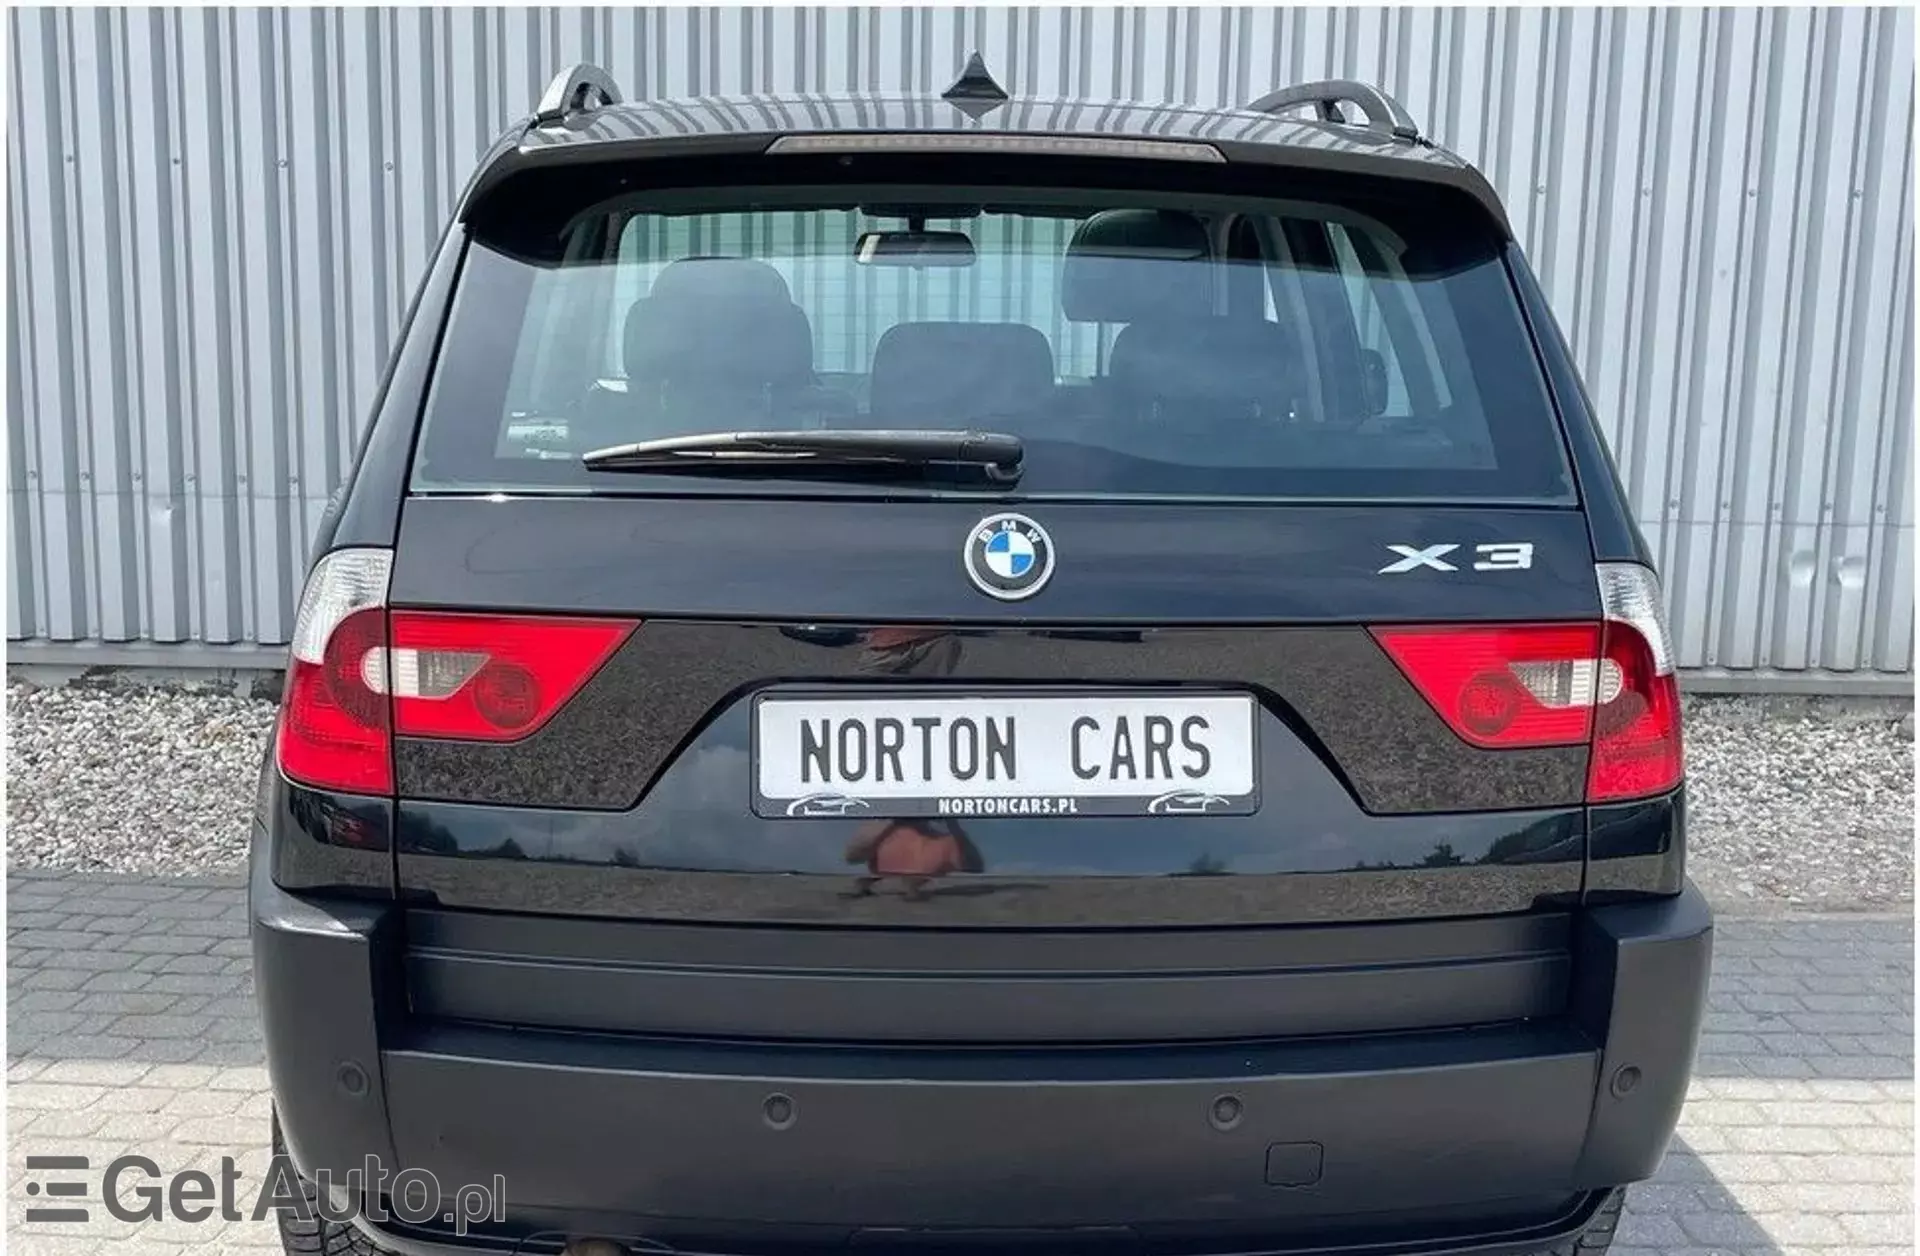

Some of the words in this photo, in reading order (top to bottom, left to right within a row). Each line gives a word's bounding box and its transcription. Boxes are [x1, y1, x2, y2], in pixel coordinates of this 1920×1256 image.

[978, 520, 1041, 543] BMW
[800, 716, 1017, 783] NORTON
[1071, 715, 1211, 780] CARS
[938, 798, 1078, 814] NORTONCARS.PL
